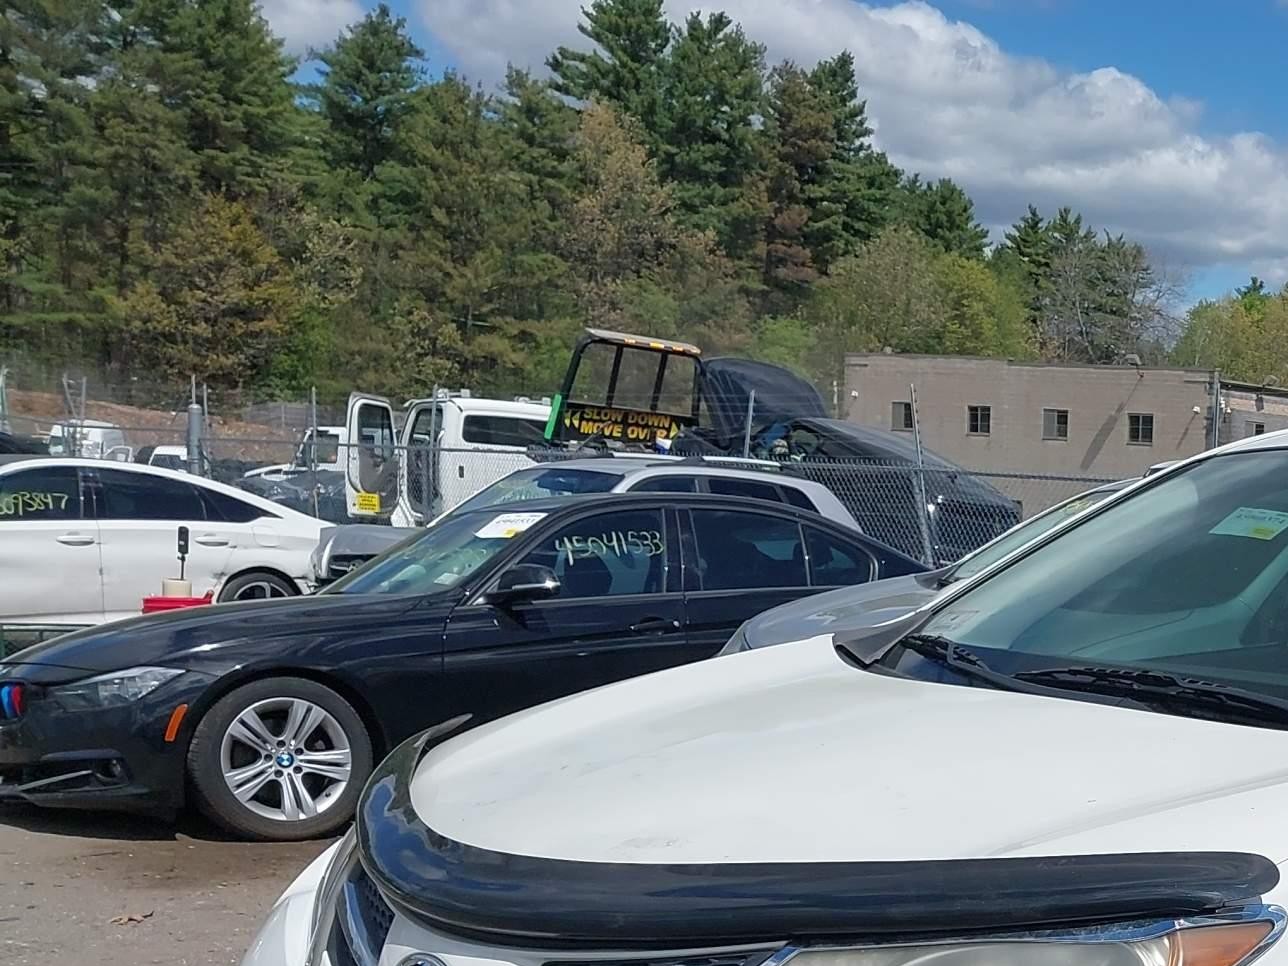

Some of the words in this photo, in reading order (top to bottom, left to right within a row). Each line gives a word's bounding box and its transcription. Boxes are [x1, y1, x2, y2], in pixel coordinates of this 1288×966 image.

[583, 407, 625, 421] SLOW
[628, 412, 671, 427] DOWN
[580, 420, 623, 437] MOVE
[627, 426, 668, 440] OVR
[554, 530, 665, 566] 45041533
